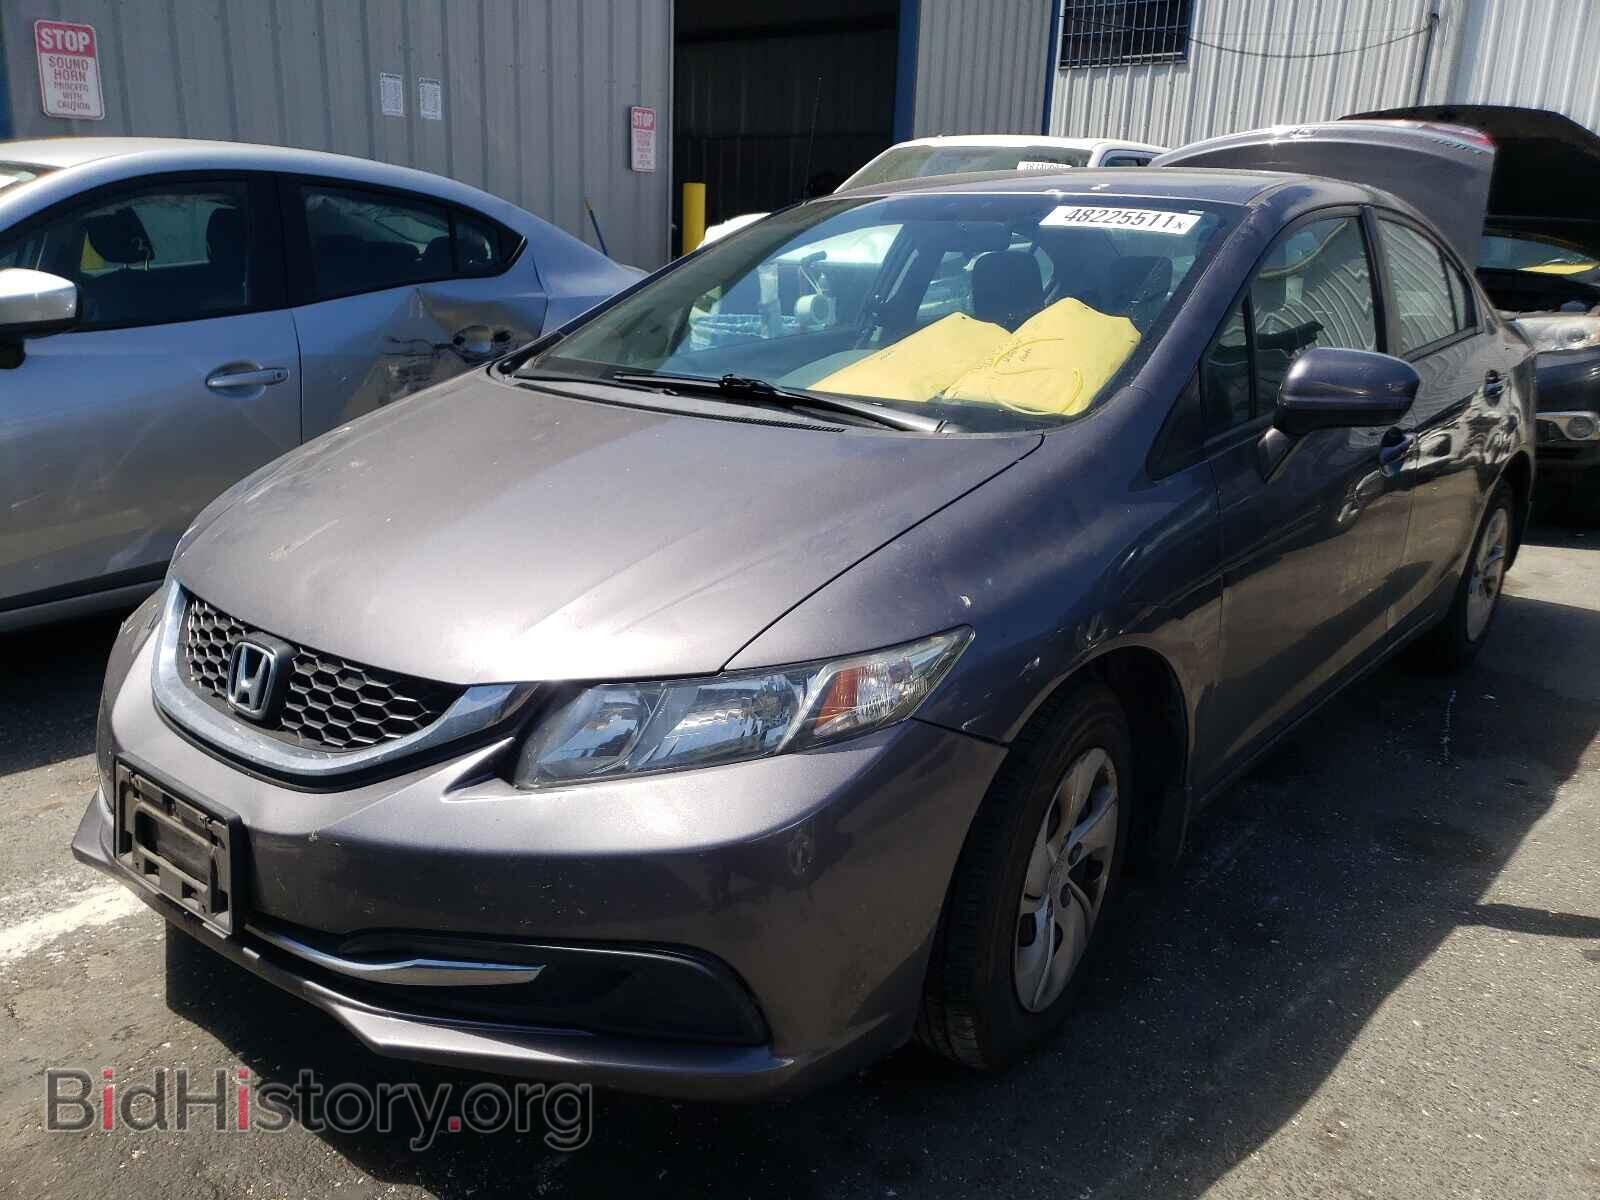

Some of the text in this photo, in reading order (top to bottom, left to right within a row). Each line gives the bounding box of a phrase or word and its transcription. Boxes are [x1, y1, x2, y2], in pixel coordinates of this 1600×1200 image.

[41, 27, 90, 52] STOP
[48, 56, 88, 71] SOUND
[54, 69, 86, 82] HORN
[633, 111, 653, 128] STOP
[1064, 208, 1175, 228] 48225511
